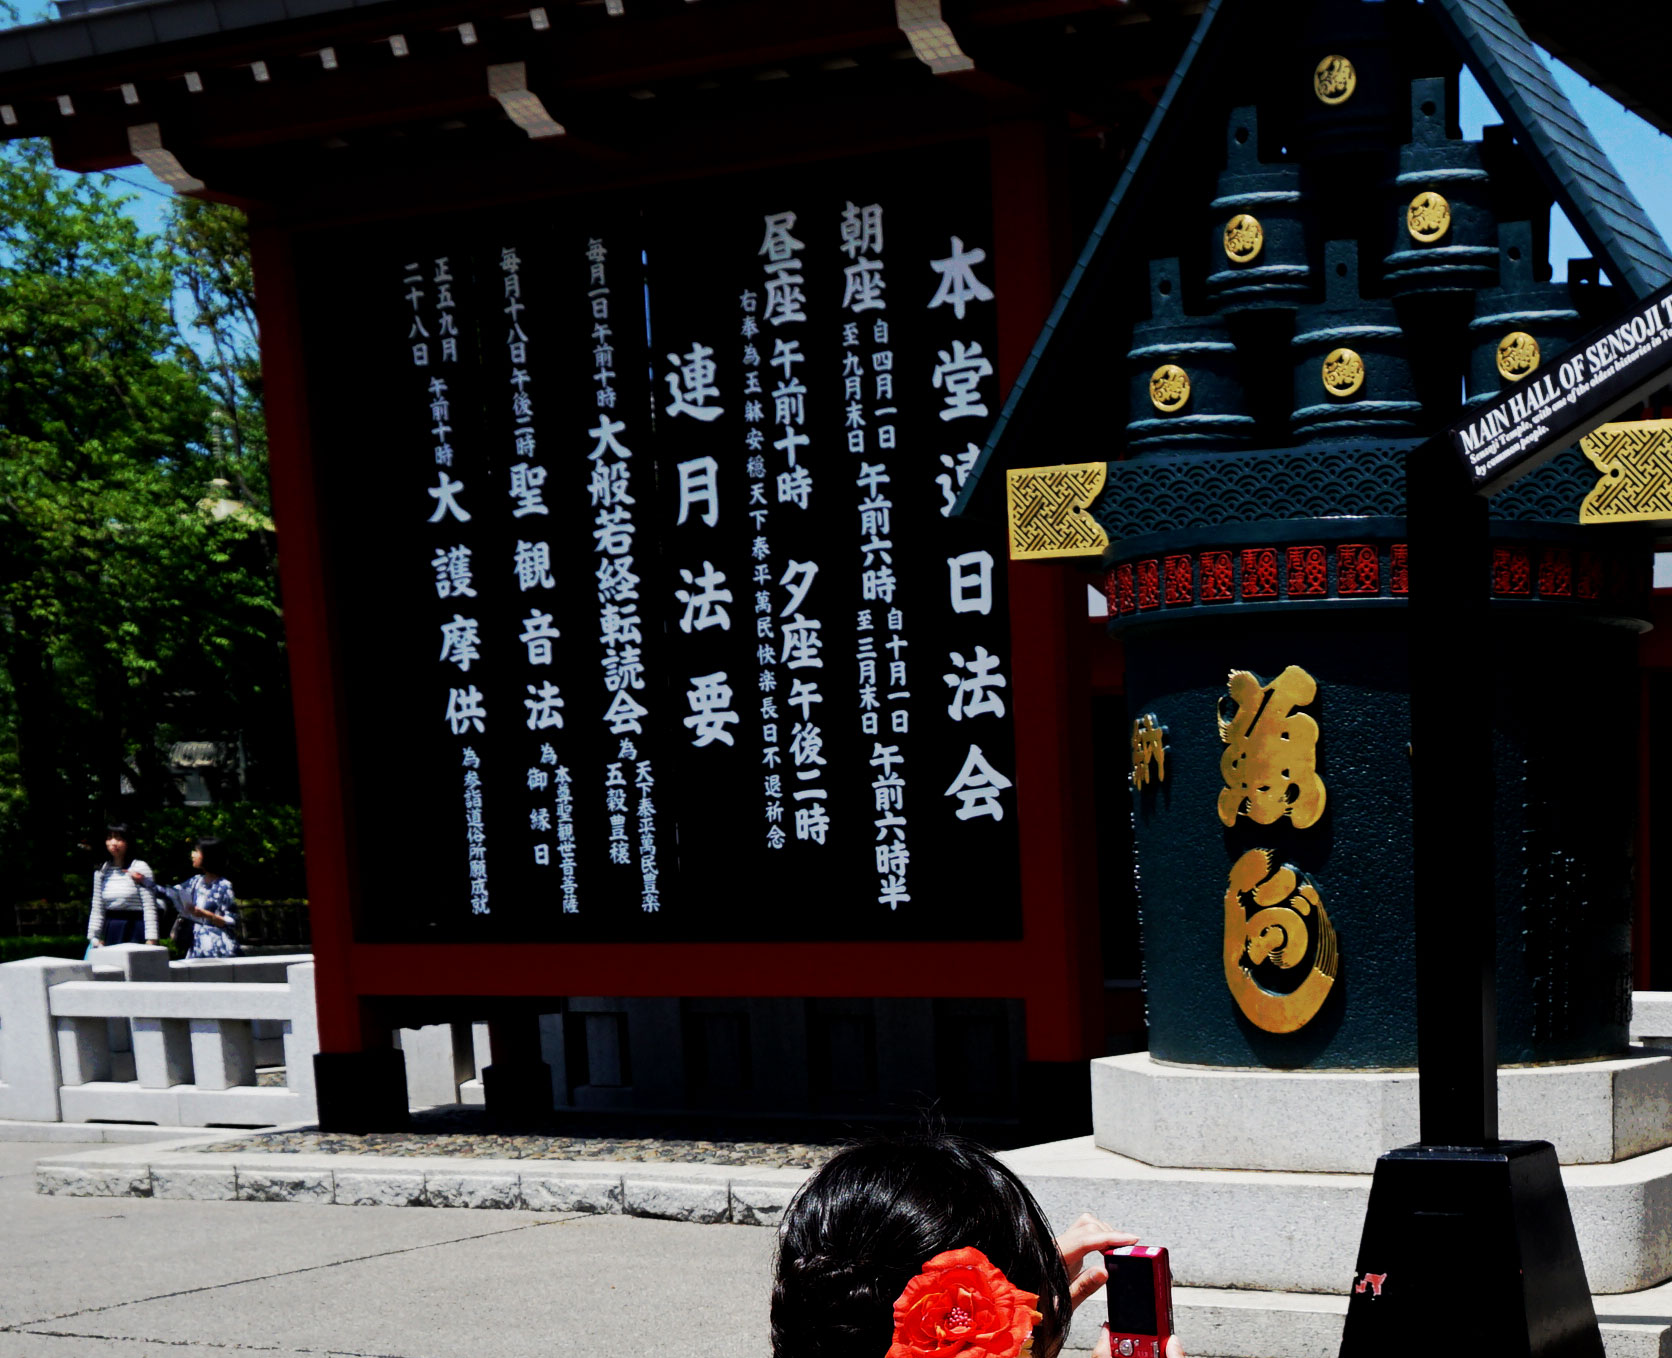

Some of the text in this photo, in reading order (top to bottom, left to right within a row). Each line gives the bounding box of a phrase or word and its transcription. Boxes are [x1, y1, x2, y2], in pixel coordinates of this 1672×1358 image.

[1459, 403, 1510, 454] MAIN
[1507, 374, 1560, 423] HALL
[1558, 353, 1584, 389] OF
[1585, 304, 1663, 373] SENSOJI
[587, 414, 648, 734] 大般若経転読会
